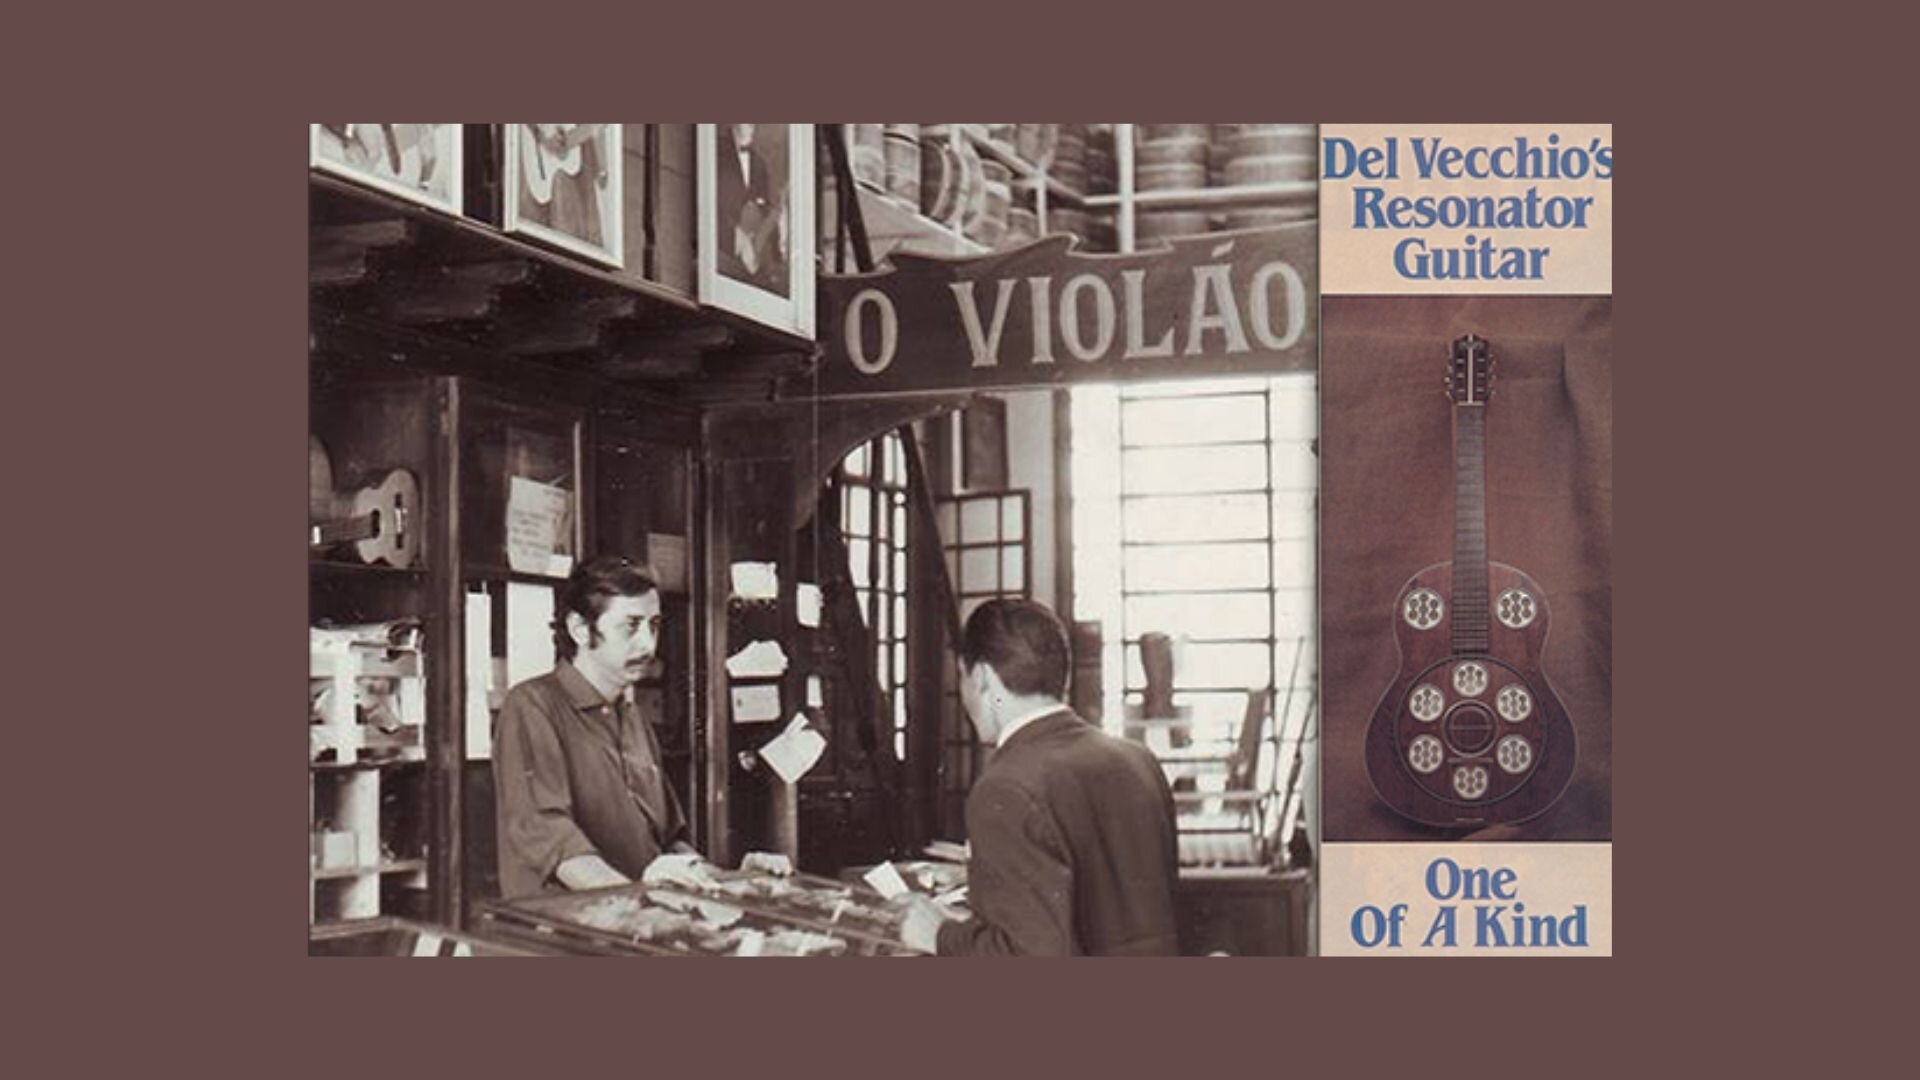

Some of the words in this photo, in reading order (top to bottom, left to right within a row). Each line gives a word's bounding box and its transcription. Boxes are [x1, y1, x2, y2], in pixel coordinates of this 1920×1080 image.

[1322, 137, 1398, 180] Del
[1409, 133, 1613, 180] Vecchio's
[1352, 186, 1594, 229] Resonator
[1393, 234, 1550, 280] Guitar
[844, 289, 898, 374] O
[1425, 858, 1517, 900] One
[1351, 903, 1408, 948] Of
[1421, 905, 1458, 947] A
[1474, 902, 1589, 947] Kind
